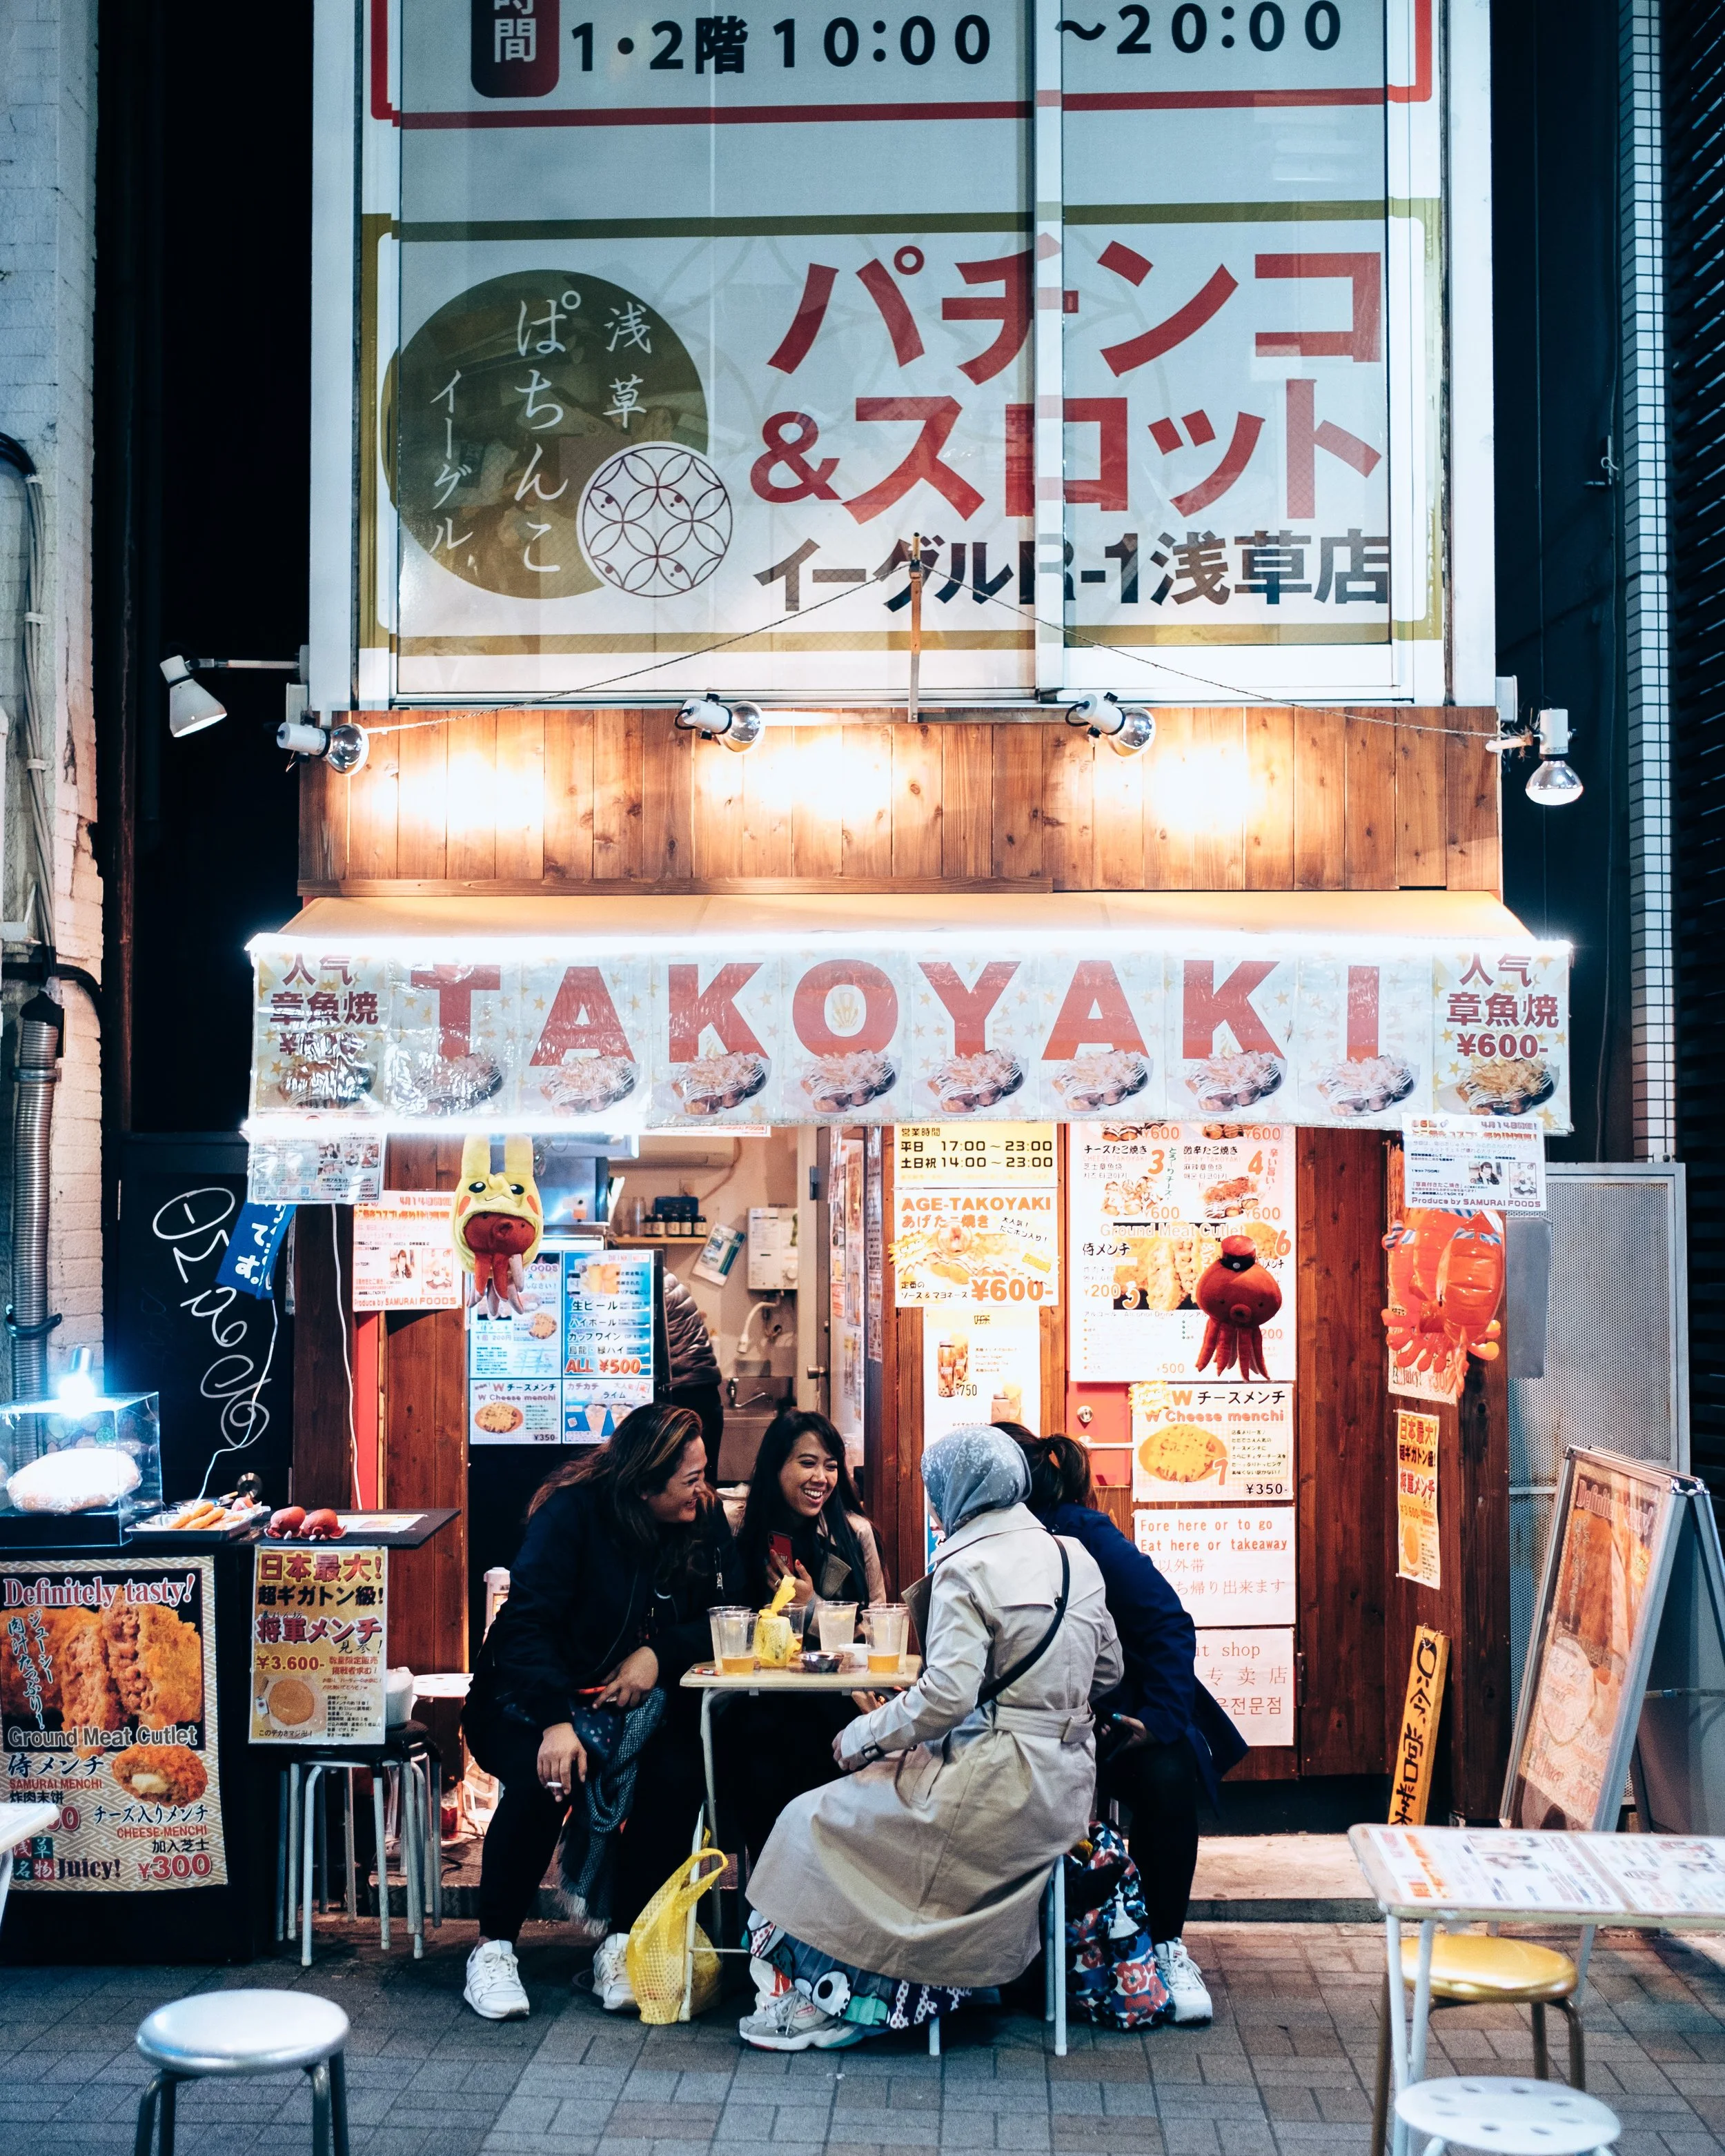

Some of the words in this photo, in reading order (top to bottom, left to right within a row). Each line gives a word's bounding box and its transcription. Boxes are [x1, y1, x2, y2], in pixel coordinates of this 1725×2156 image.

[767, 233, 1381, 385] パチンコ
[603, 301, 652, 428] 浅草
[514, 290, 581, 573] ぱちんこ
[430, 370, 473, 553] イーグル
[1459, 951, 1532, 987] 人气
[411, 958, 1381, 1067] TAKOYAKI
[1447, 991, 1559, 1028] 章魚焼
[1457, 1033, 1548, 1058] ¥600-
[901, 1127, 940, 1137] 営業時間
[900, 1140, 924, 1152] 平日
[941, 1140, 985, 1151] 17:00
[1005, 1140, 1052, 1151] 23:00
[900, 1157, 936, 1169] 土日祝
[941, 1156, 987, 1167] 14:00
[1006, 1156, 1053, 1167] 23:00
[1147, 1149, 1165, 1174] 3
[1248, 1149, 1263, 1175] 4
[901, 1196, 1051, 1211] AGE-TAKOYAKI
[1463, 1198, 1506, 1207] SAMURAI
[1100, 1223, 1154, 1237] Ground
[1159, 1223, 1196, 1237] Meat
[1201, 1223, 1246, 1237] Cutlet
[1083, 1243, 1130, 1256] 侍メンチ
[1276, 1229, 1292, 1256] 6
[525, 1263, 559, 1272] OODS
[971, 1278, 1054, 1301] ¥600-
[385, 1297, 417, 1306] SAMURAI
[420, 1296, 457, 1305] FOODS
[572, 1300, 618, 1311] 生ビール
[564, 1358, 594, 1373] ALL
[493, 1383, 505, 1392] W
[1172, 1390, 1193, 1406] W
[1145, 1410, 1162, 1423] W
[1165, 1410, 1223, 1423] Cheese
[1228, 1410, 1284, 1421] menchi
[1245, 1483, 1288, 1494] ¥350-
[1141, 1519, 1170, 1532] Fore
[1178, 1519, 1207, 1532] here
[1214, 1521, 1229, 1531] or
[1238, 1520, 1250, 1530] to
[1259, 1521, 1273, 1532] go
[1141, 1539, 1162, 1552] Eat
[1170, 1539, 1200, 1552] here
[1208, 1541, 1221, 1551] or
[1231, 1538, 1288, 1551] takeaway
[261, 1553, 382, 1582] 日本最大!
[1151, 1558, 1205, 1574] 以外带
[3, 1576, 118, 1608] Definitely
[125, 1573, 196, 1607] tasty!
[257, 1616, 382, 1645] 将軍メンチ
[1221, 1642, 1261, 1659] shop
[8, 1726, 79, 1748] Ground
[83, 1726, 132, 1747] Meat
[137, 1724, 198, 1746] Cutlet
[8, 1754, 104, 1778] 侍メンチ
[10, 1778, 58, 1790] SAMURAI
[61, 1778, 102, 1789] MENCHI
[94, 1803, 209, 1824] チーズ入りメンチ
[152, 1839, 210, 1853] 加入芝士
[16, 1859, 52, 1878] 名物
[57, 1858, 121, 1880] Juicy!
[138, 1853, 212, 1880] ¥300
